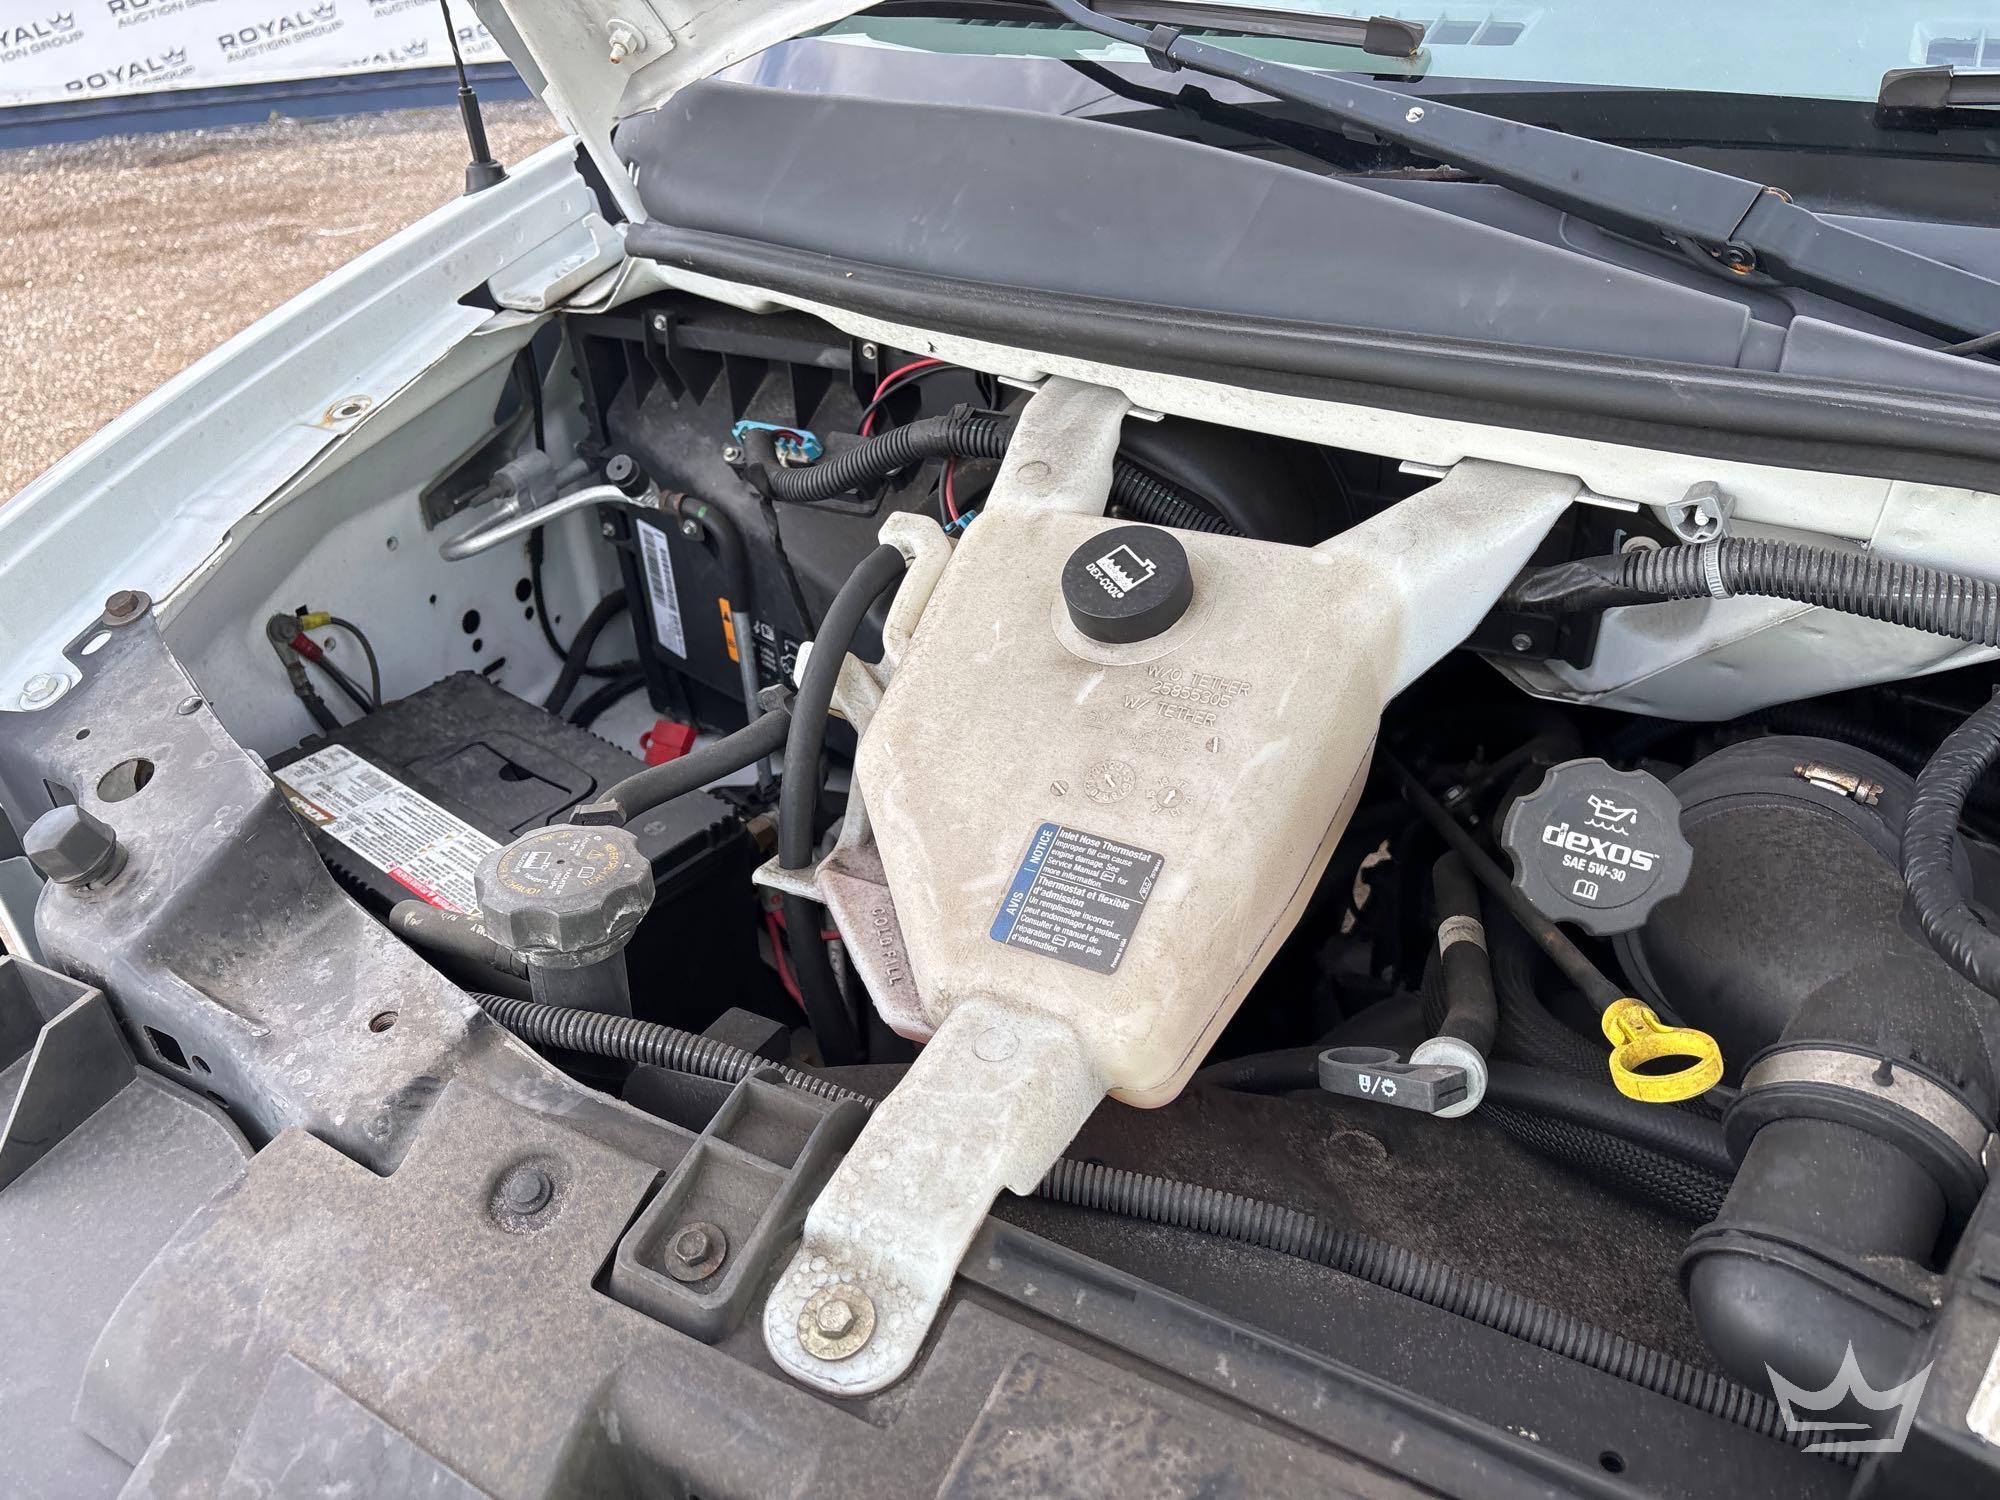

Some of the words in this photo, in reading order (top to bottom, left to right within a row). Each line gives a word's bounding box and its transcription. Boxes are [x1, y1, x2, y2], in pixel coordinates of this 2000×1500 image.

[0, 22, 50, 47] YAL
[29, 31, 84, 55] GROUP
[218, 11, 313, 50] ROYAL
[1148, 665, 1182, 681] W/O
[1191, 671, 1251, 697] TETHER
[1150, 680, 1232, 708] 25855305
[1123, 695, 1150, 711] W/
[1157, 702, 1217, 727] TETHER
[1030, 830, 1053, 864] NOTICE
[1055, 840, 1085, 854] Improper
[1087, 847, 1096, 856] fill
[1097, 852, 1110, 861] can
[1111, 855, 1132, 867] cause
[1060, 829, 1079, 842] Inlet
[1080, 835, 1101, 848] Hose
[1102, 841, 1152, 862] Thermostat
[1542, 822, 1654, 871] dexos
[1047, 857, 1072, 870] Service
[1073, 864, 1100, 877] Manual
[1117, 876, 1128, 886] for
[1051, 850, 1073, 862] engine
[1075, 855, 1103, 869] damage.
[1106, 863, 1120, 873] See
[1562, 854, 1585, 871] SAE
[1587, 860, 1627, 882] 5W-30
[1042, 865, 1060, 877] more
[1062, 870, 1102, 888] information.
[1006, 892, 1023, 916] AVIS
[1033, 886, 1084, 908] d'admission
[1038, 876, 1085, 897] Thermostat
[1087, 890, 1097, 900] et
[1099, 893, 1130, 910] flexible
[1024, 906, 1040, 918] peut
[1041, 910, 1087, 930] endommager
[1095, 927, 1120, 940] moteur.
[1029, 896, 1038, 904] Un
[1039, 899, 1081, 918] remplissage
[1082, 911, 1115, 927] incorrect
[1020, 914, 1053, 931] Consulter
[1062, 927, 1088, 940] manuel
[1089, 935, 1099, 944] de
[872, 908, 893, 946] COLD
[884, 950, 903, 987] FILL
[1068, 940, 1085, 951] pour
[1086, 945, 1102, 956] plus
